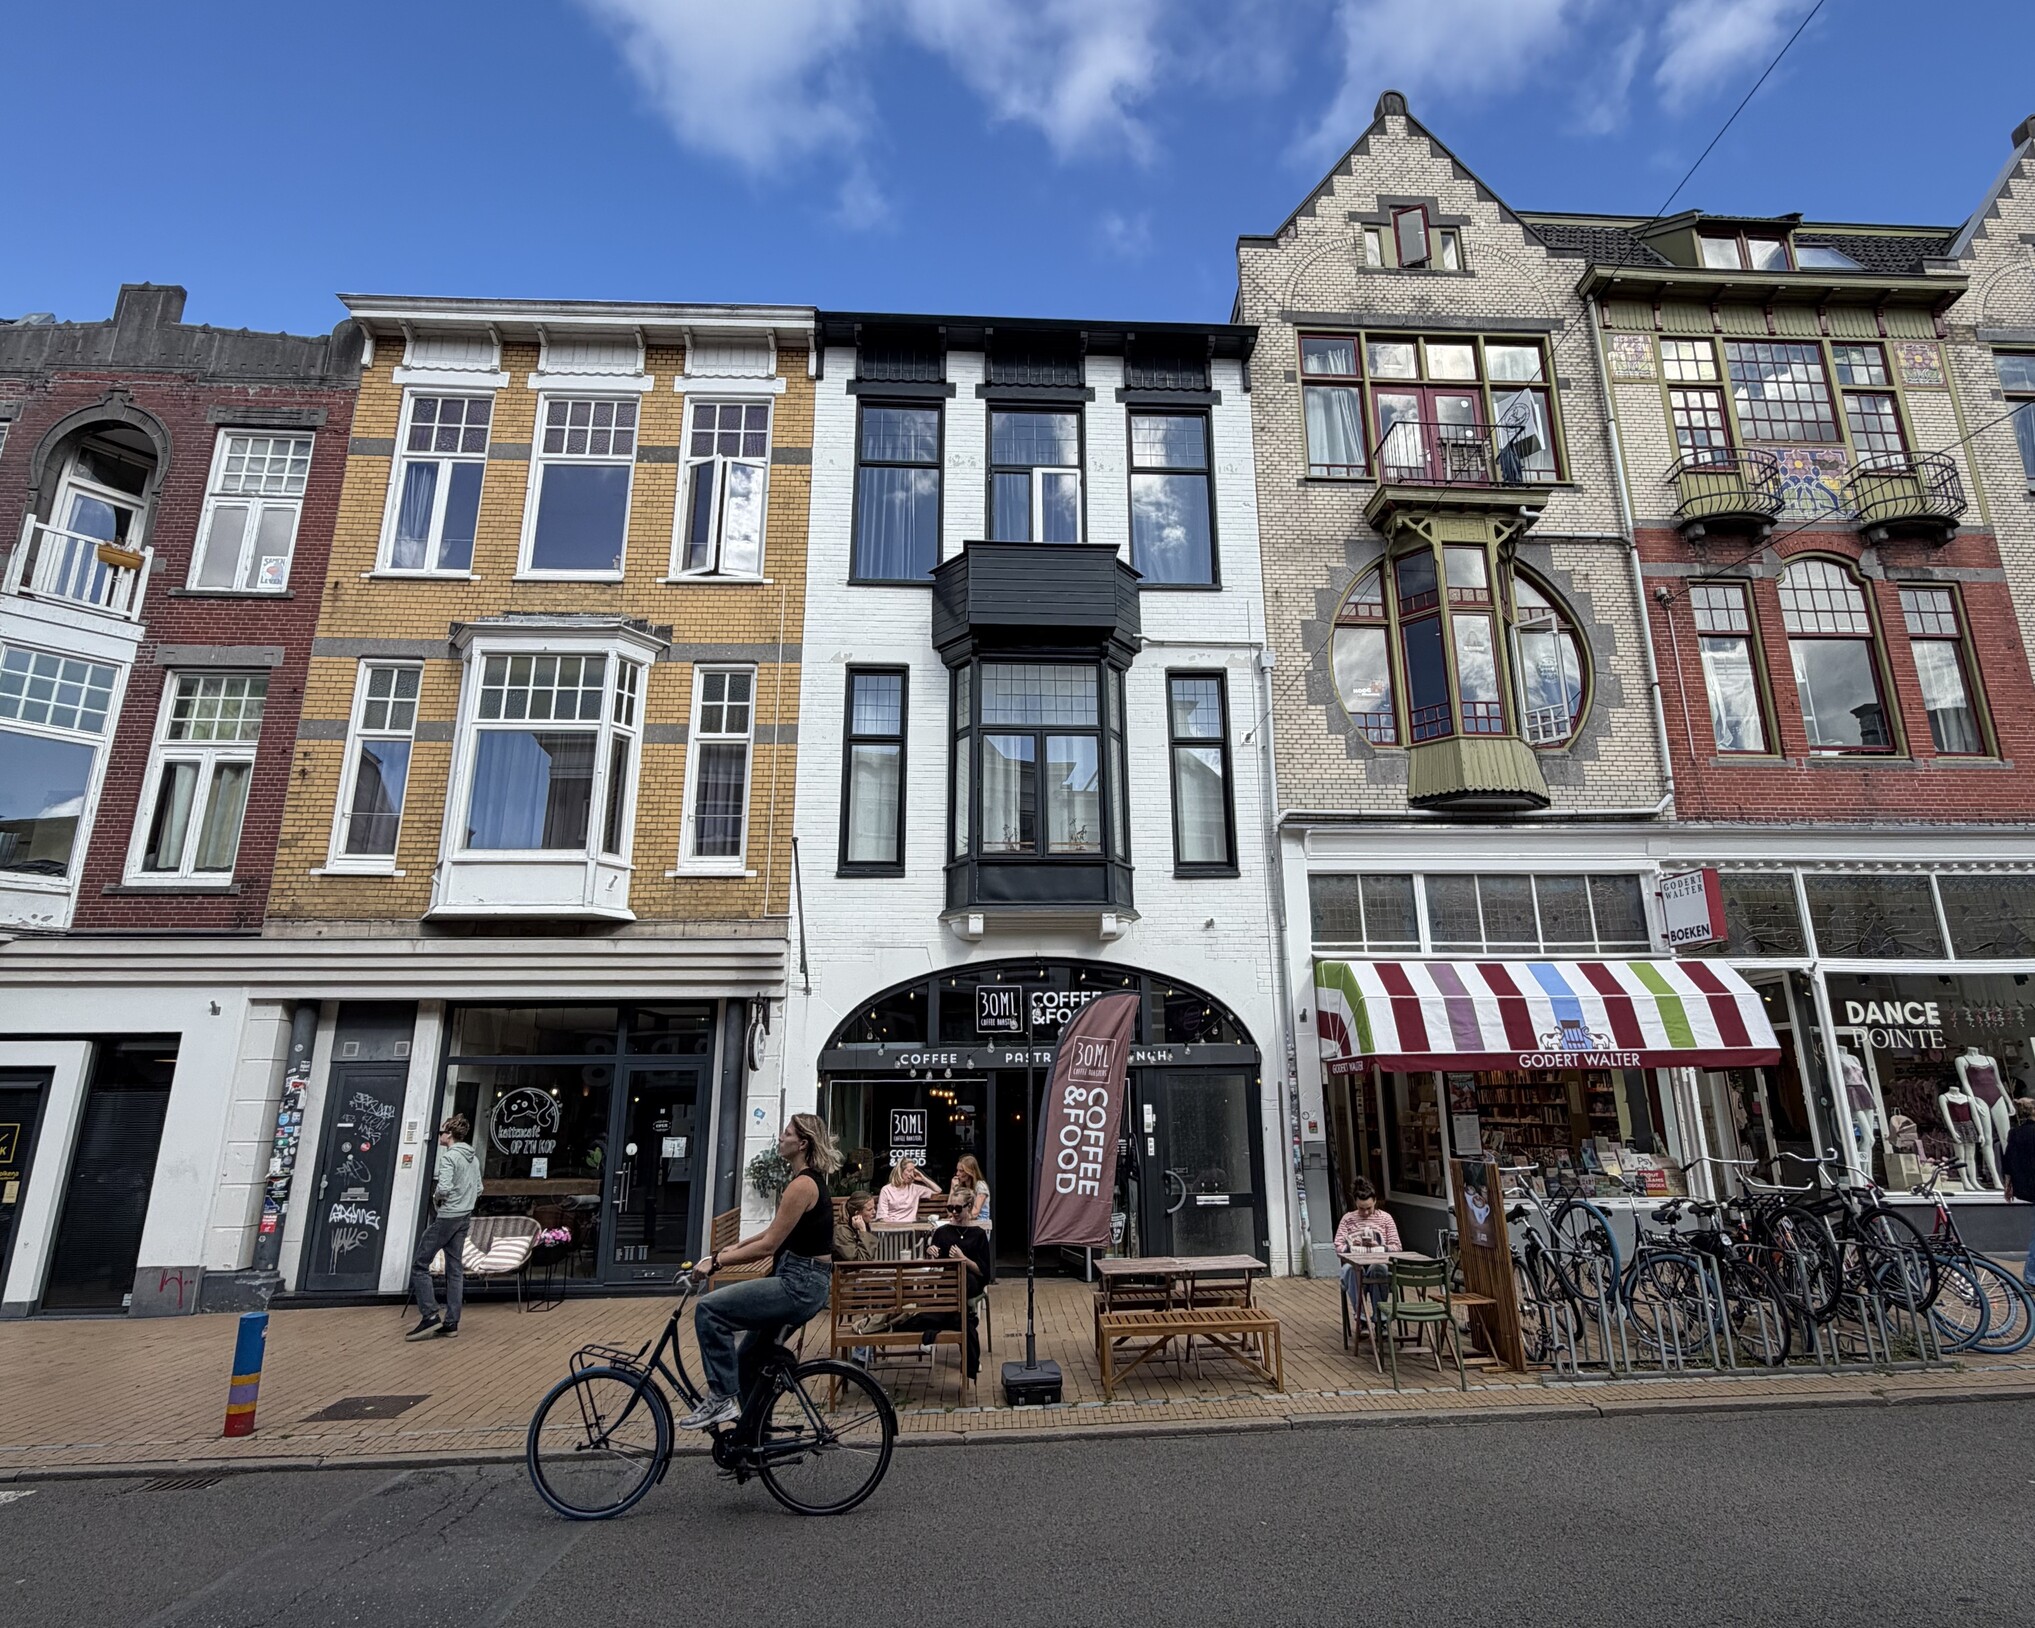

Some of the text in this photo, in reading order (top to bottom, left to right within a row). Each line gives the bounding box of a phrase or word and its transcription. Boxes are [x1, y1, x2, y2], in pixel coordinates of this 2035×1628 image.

[1663, 874, 1702, 892] GODERT
[1665, 884, 1703, 900] WALTER
[1670, 923, 1711, 942] BOEKEN
[980, 991, 1018, 1016] 30ML
[1031, 991, 1102, 1007] COFFE
[1031, 1008, 1078, 1025] &FO
[1845, 1000, 1942, 1025] DANCE
[1852, 1027, 1947, 1049] POINTE
[900, 1051, 1167, 1065] COFFEE PASTR NCH
[1075, 1042, 1109, 1068] 30ML
[1519, 1053, 1641, 1068] GODERT WALTER
[893, 1114, 923, 1135] 30ML
[510, 1139, 523, 1154] OP
[538, 1139, 557, 1154] KOP
[1055, 1085, 1088, 1194] &FOOD
[1077, 1087, 1109, 1197] COFFEE
[889, 1149, 927, 1158] COFFEE
